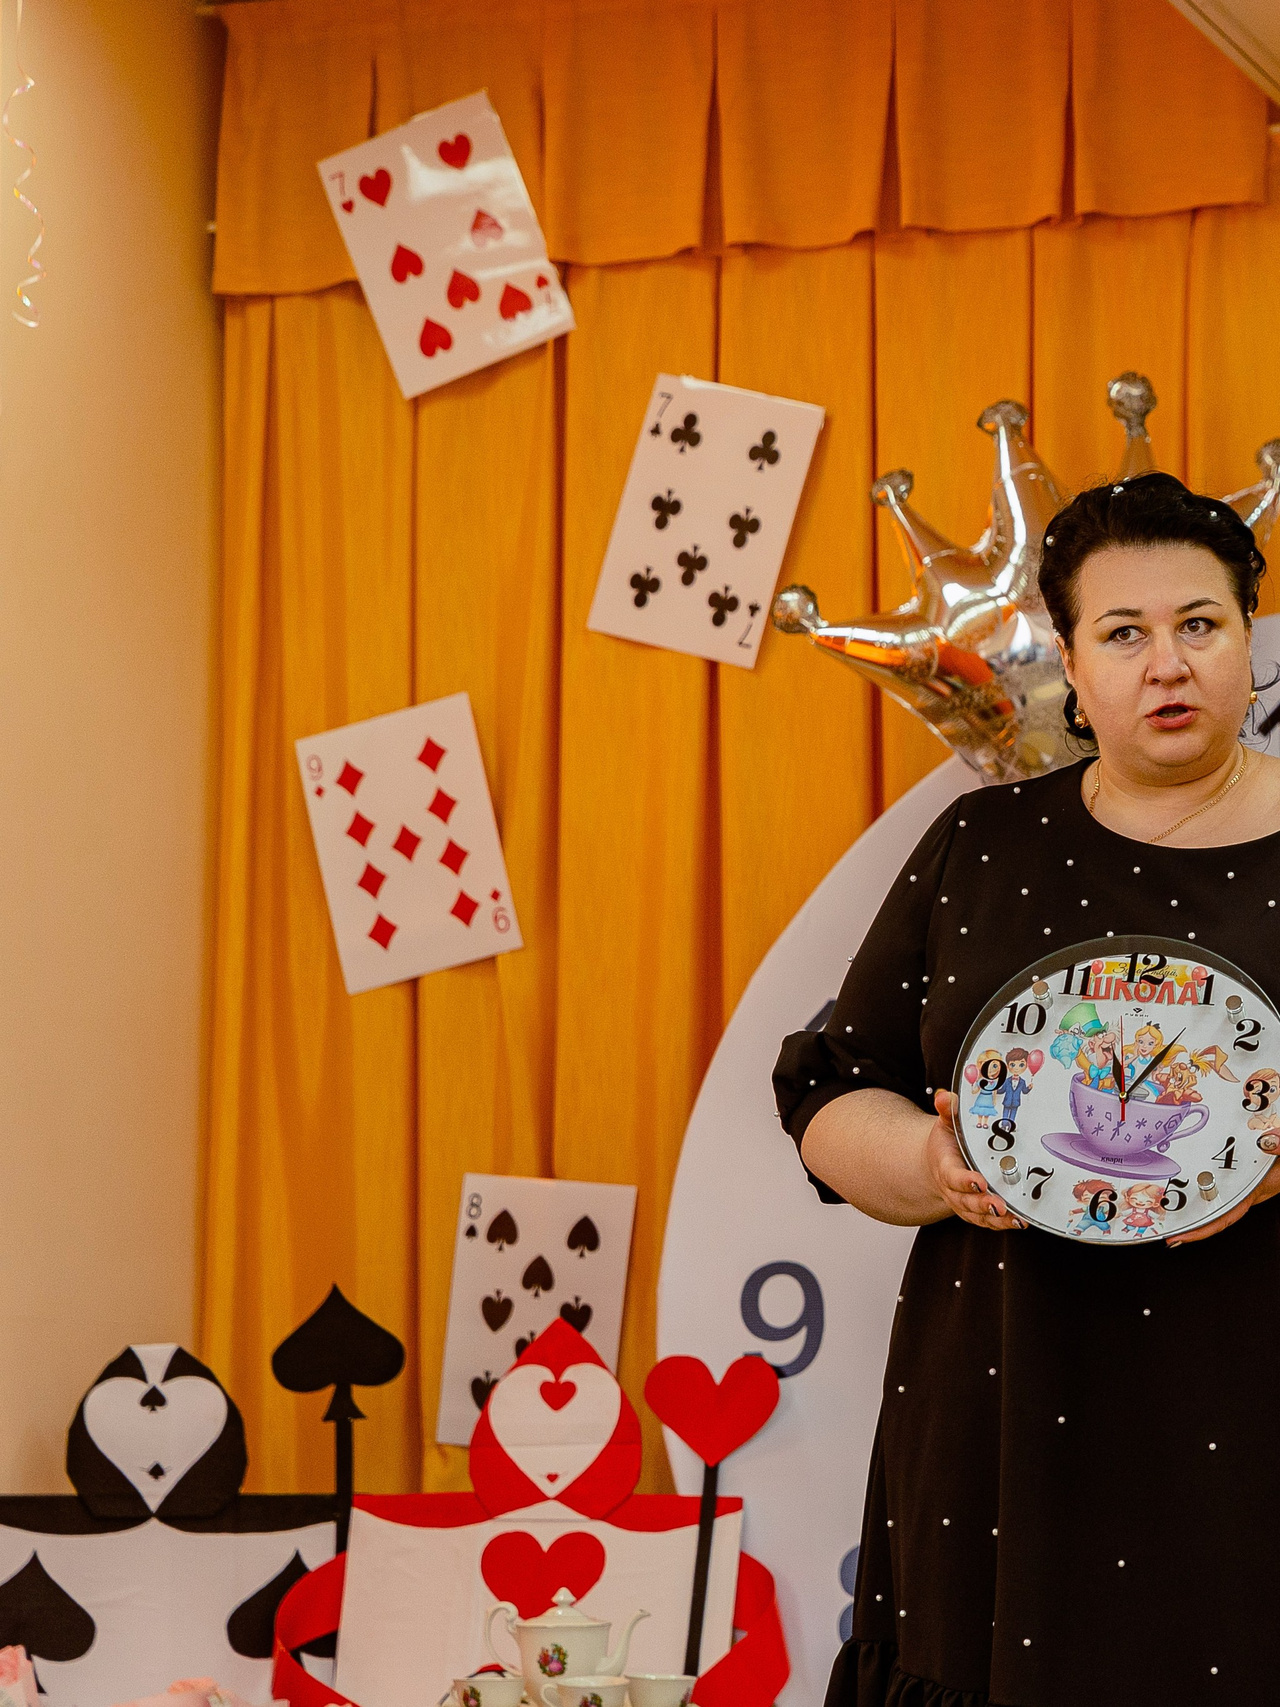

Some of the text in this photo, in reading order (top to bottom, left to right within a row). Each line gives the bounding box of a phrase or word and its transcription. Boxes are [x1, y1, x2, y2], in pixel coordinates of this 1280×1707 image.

[659, 392, 674, 418] 7
[737, 623, 753, 649] 7
[306, 754, 324, 781] 9
[492, 906, 511, 934] 9
[1058, 964, 1092, 997] 11
[1122, 952, 1168, 985] 12
[1082, 975, 1199, 1006] ШКОЛА
[1199, 975, 1215, 1006] 1
[1001, 1002, 1047, 1036] 10
[1234, 1019, 1262, 1051] 2
[980, 1059, 1007, 1091] 9
[1242, 1079, 1270, 1112] 3
[988, 1118, 1016, 1151] 8
[1212, 1136, 1238, 1170] 4
[1026, 1167, 1054, 1199] 7
[1160, 1179, 1189, 1212] 5
[466, 1193, 483, 1221] 8
[1089, 1189, 1118, 1222] 6
[741, 1261, 824, 1376] 9
